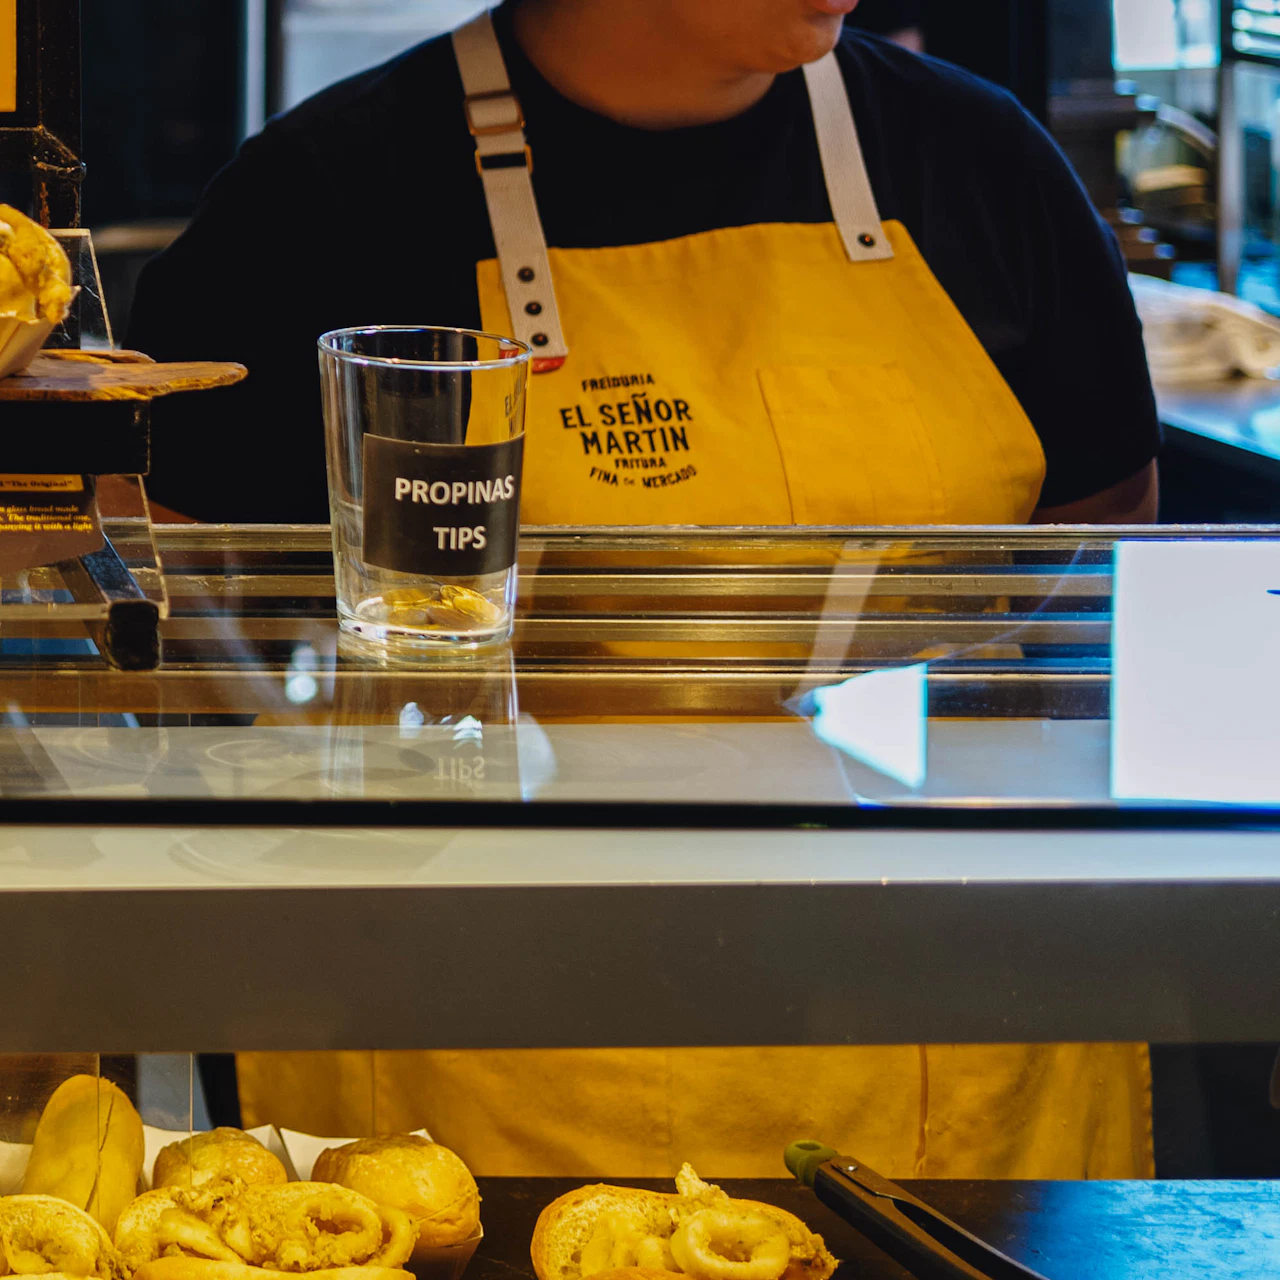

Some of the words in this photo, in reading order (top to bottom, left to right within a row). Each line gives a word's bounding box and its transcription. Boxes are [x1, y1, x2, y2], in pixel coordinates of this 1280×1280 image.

[559, 405, 592, 429] EL
[598, 391, 693, 426] SEÑOR
[580, 426, 690, 455] MARTIN
[589, 466, 618, 487] FINA
[642, 464, 697, 489] MERCADO
[614, 457, 667, 469] FRITURA
[394, 474, 515, 505] PROPINAS
[432, 525, 487, 551] TIPS
